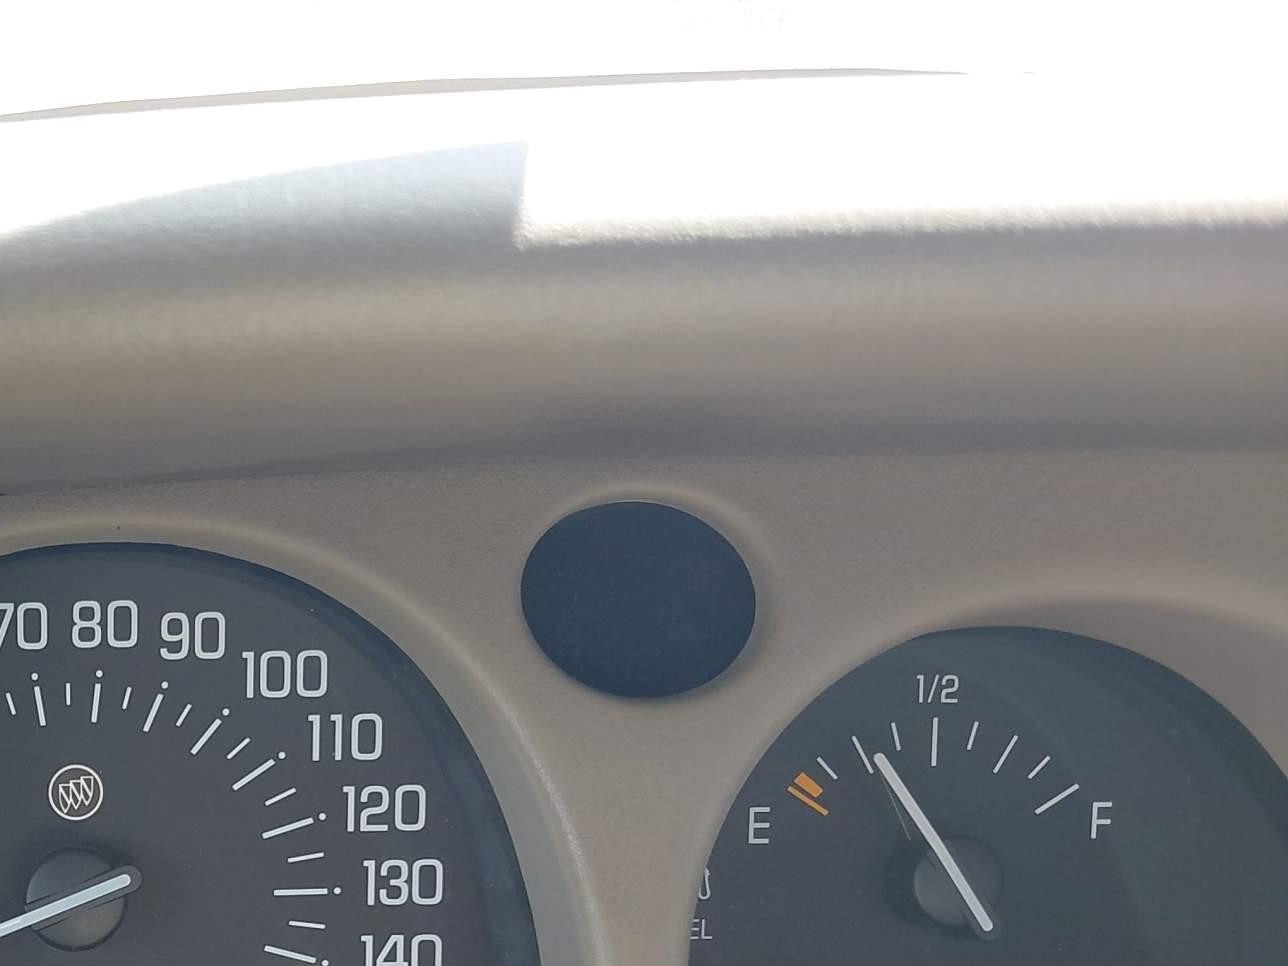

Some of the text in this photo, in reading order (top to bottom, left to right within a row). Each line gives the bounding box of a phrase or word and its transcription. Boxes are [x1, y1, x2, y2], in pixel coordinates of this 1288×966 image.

[72, 600, 137, 648] 80
[160, 612, 225, 659] 90
[243, 650, 327, 698] 100
[917, 675, 958, 703] 1/2
[308, 714, 382, 761] 110
[343, 785, 425, 831] 120
[749, 807, 770, 843] E
[1091, 802, 1112, 838] F
[363, 859, 443, 905] 130
